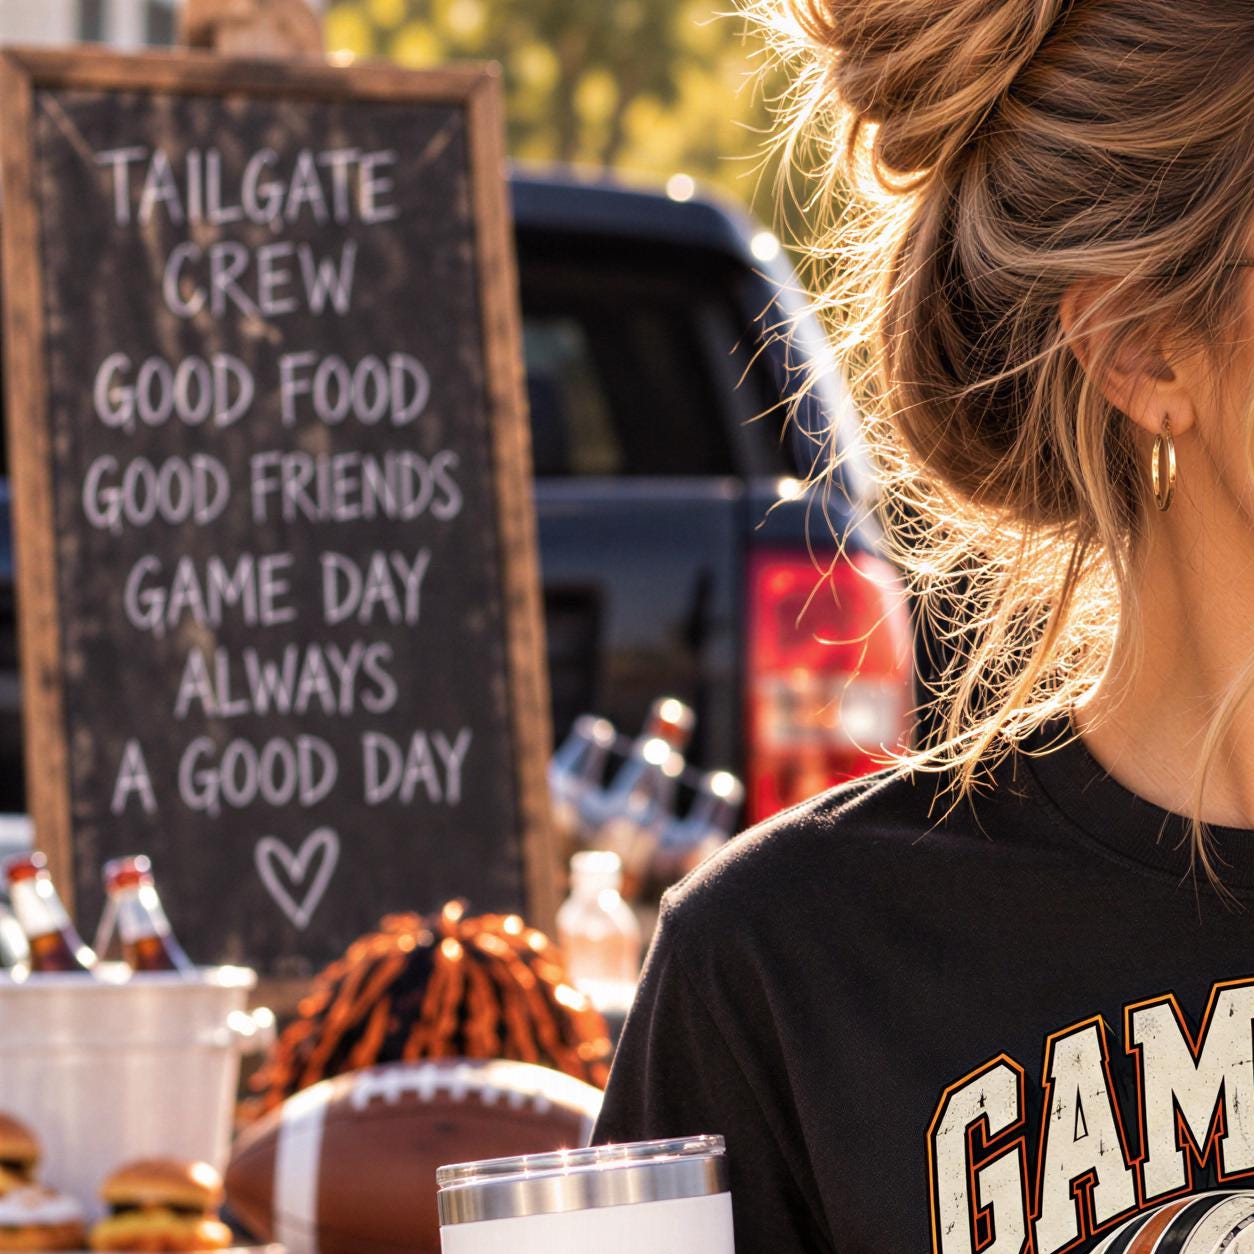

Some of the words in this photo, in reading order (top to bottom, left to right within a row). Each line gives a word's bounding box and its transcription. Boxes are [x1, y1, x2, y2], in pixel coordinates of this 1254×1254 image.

[100, 147, 399, 228] TAILGATE
[163, 241, 357, 318] CREW
[94, 352, 254, 432] GOOD
[278, 351, 431, 426] FOOD
[83, 455, 230, 531] GOOD
[251, 450, 463, 523] FRIENDS
[125, 553, 296, 636] GAME
[322, 548, 432, 626] DAY
[174, 643, 399, 717] ALWAYS
[111, 740, 156, 815] A
[178, 734, 338, 819] GOOD
[363, 728, 471, 805] DAY
